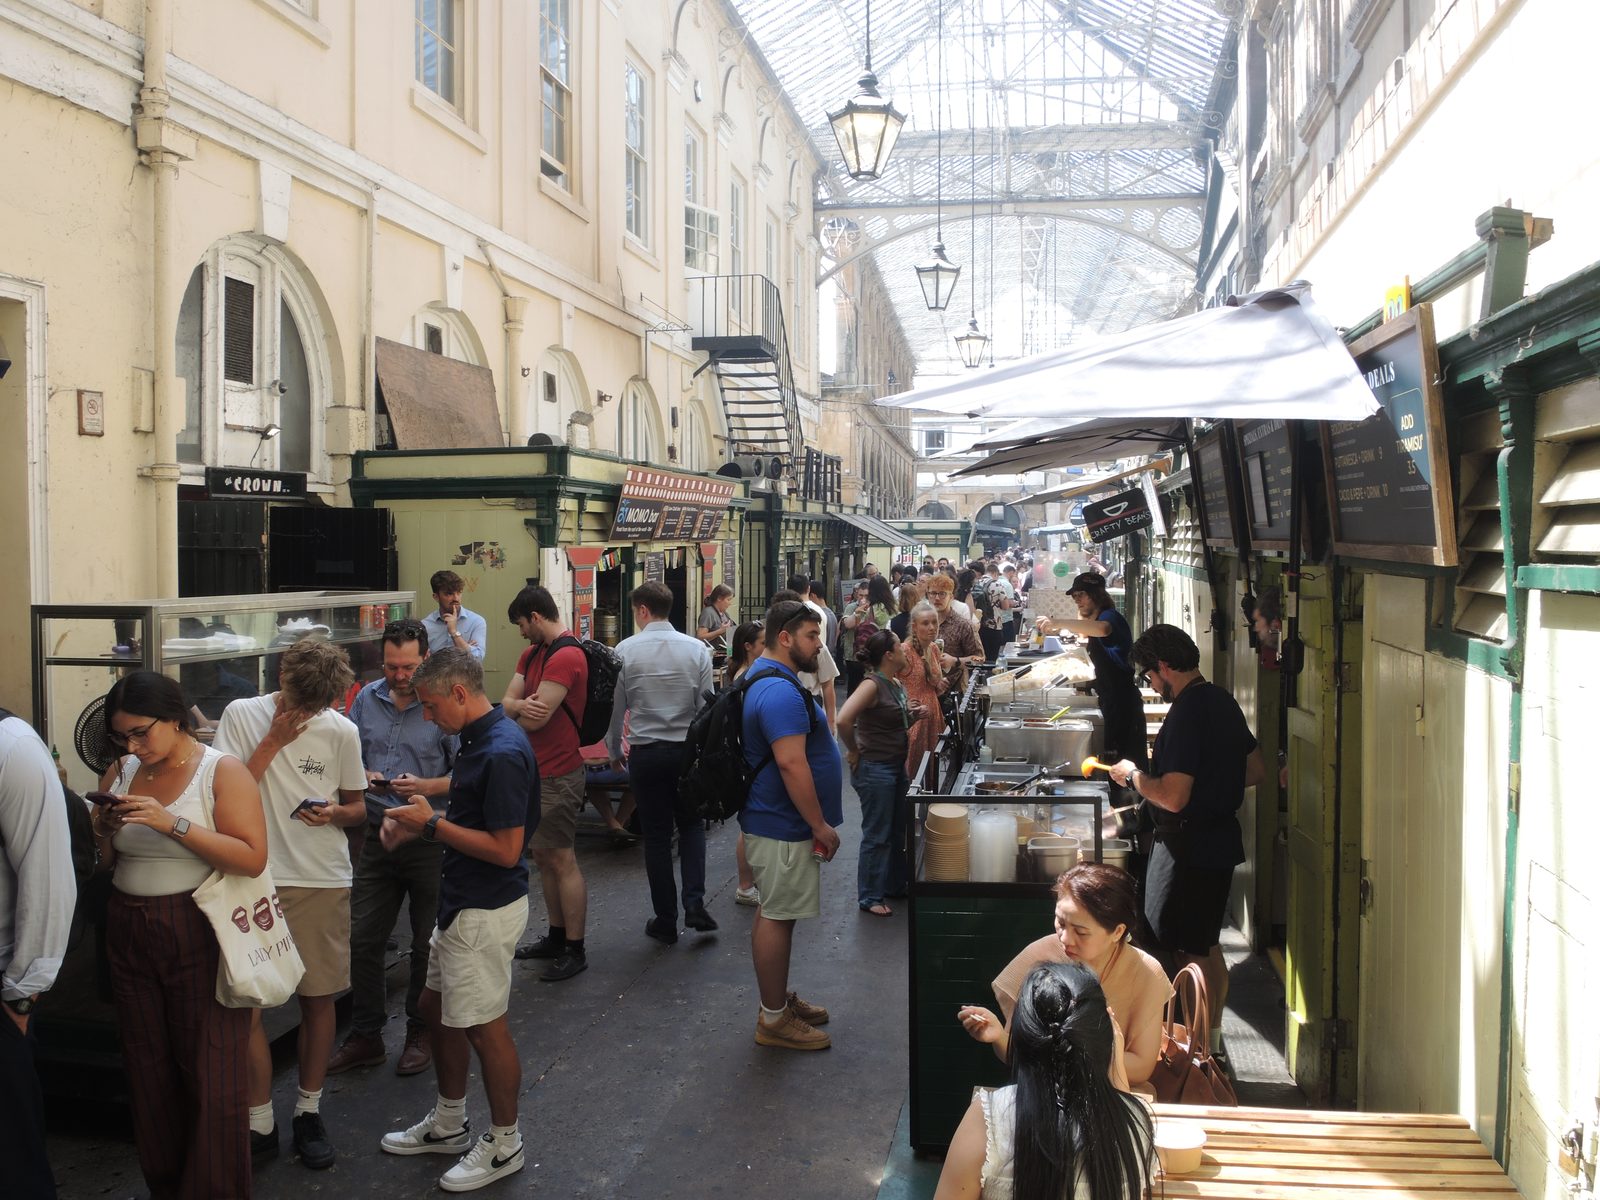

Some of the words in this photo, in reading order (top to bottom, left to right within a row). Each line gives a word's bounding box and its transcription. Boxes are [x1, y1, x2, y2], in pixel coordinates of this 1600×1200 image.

[1368, 361, 1396, 390] DEALS
[1401, 414, 1414, 431] ADD
[234, 476, 282, 493] CROWN
[625, 508, 651, 523] MOMO
[648, 509, 660, 523] bar
[1091, 520, 1121, 539] CRAFTY
[1124, 511, 1151, 526] BEANS
[247, 945, 273, 967] LADY
